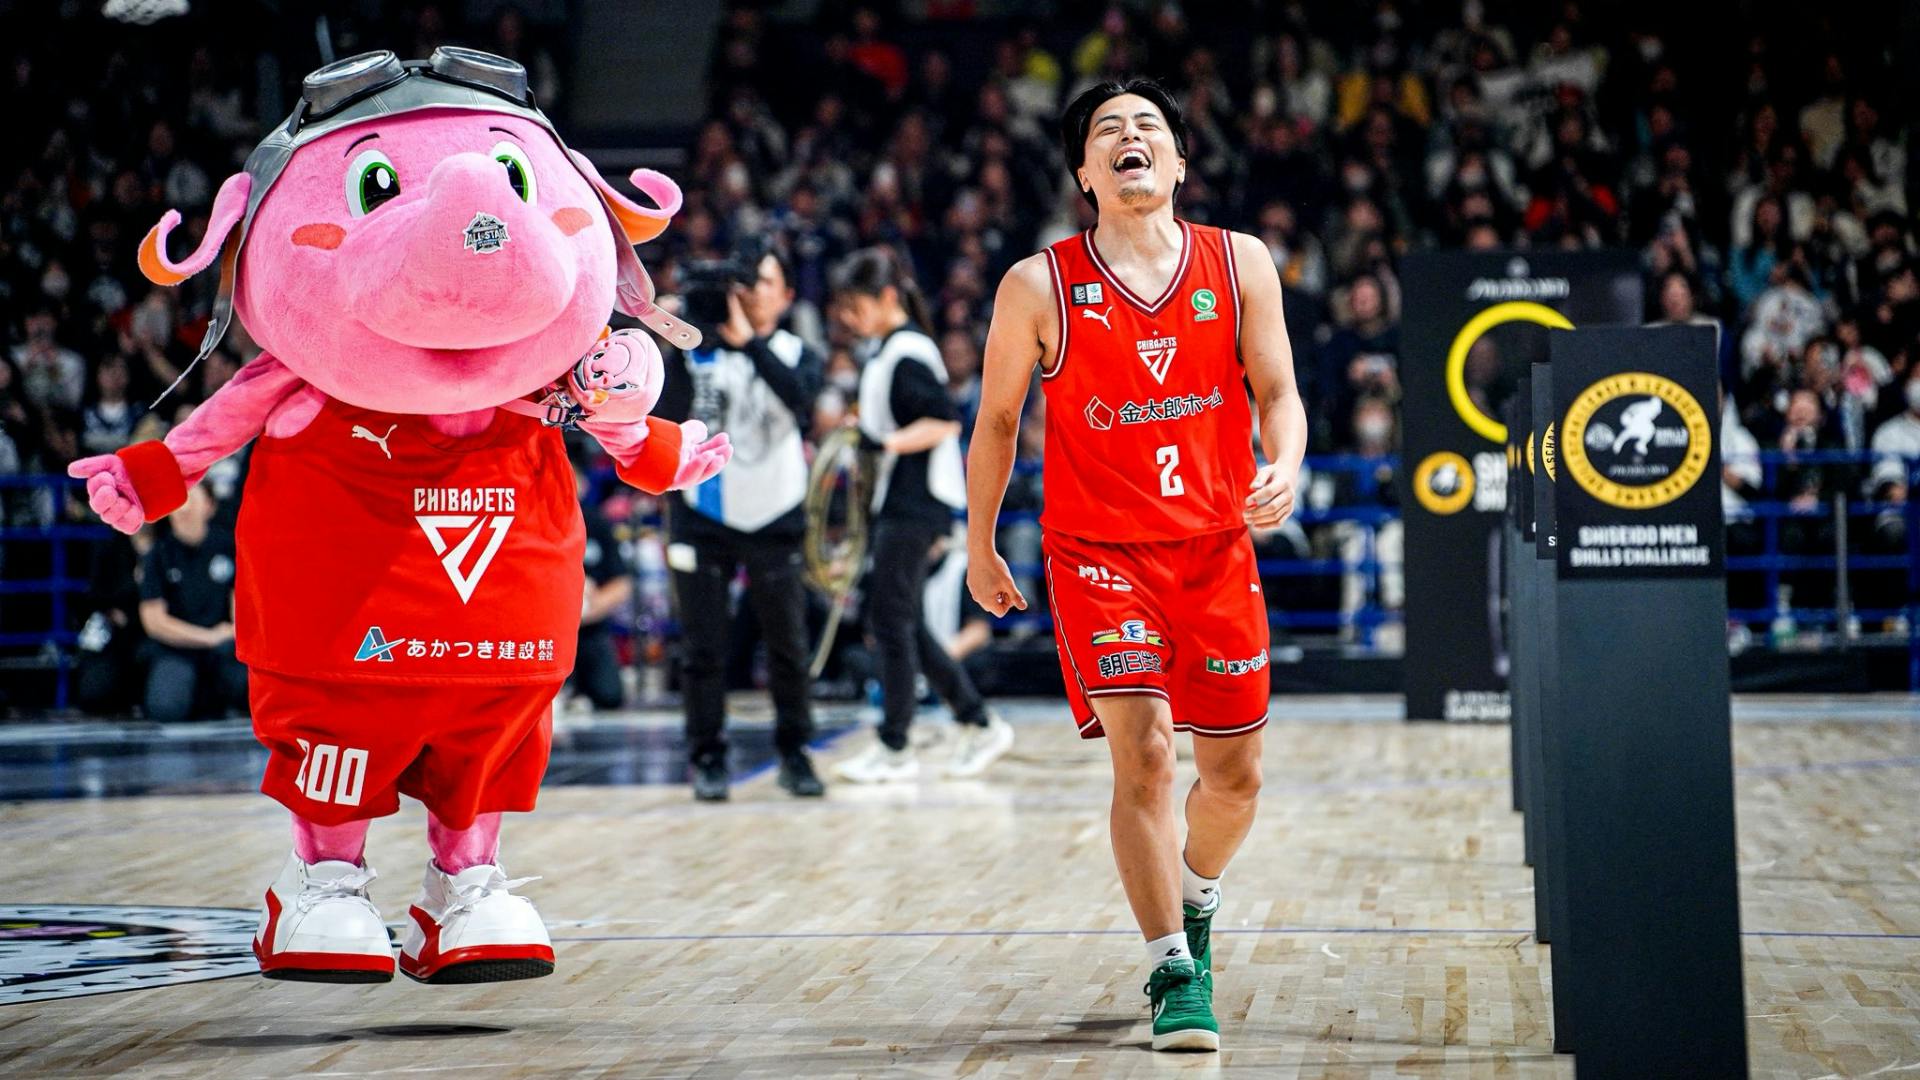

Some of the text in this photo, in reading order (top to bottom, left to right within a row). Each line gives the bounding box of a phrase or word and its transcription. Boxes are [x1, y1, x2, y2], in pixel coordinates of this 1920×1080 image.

[1136, 336, 1177, 351] CHIBAJETS
[1119, 386, 1223, 424] 金太郎ホーム
[1156, 444, 1185, 497] 2
[414, 488, 515, 512] CHIBAJETS
[1659, 524, 1698, 545] MEN
[1623, 545, 1710, 566] CHALLENGE
[407, 639, 535, 660] あかつき建設
